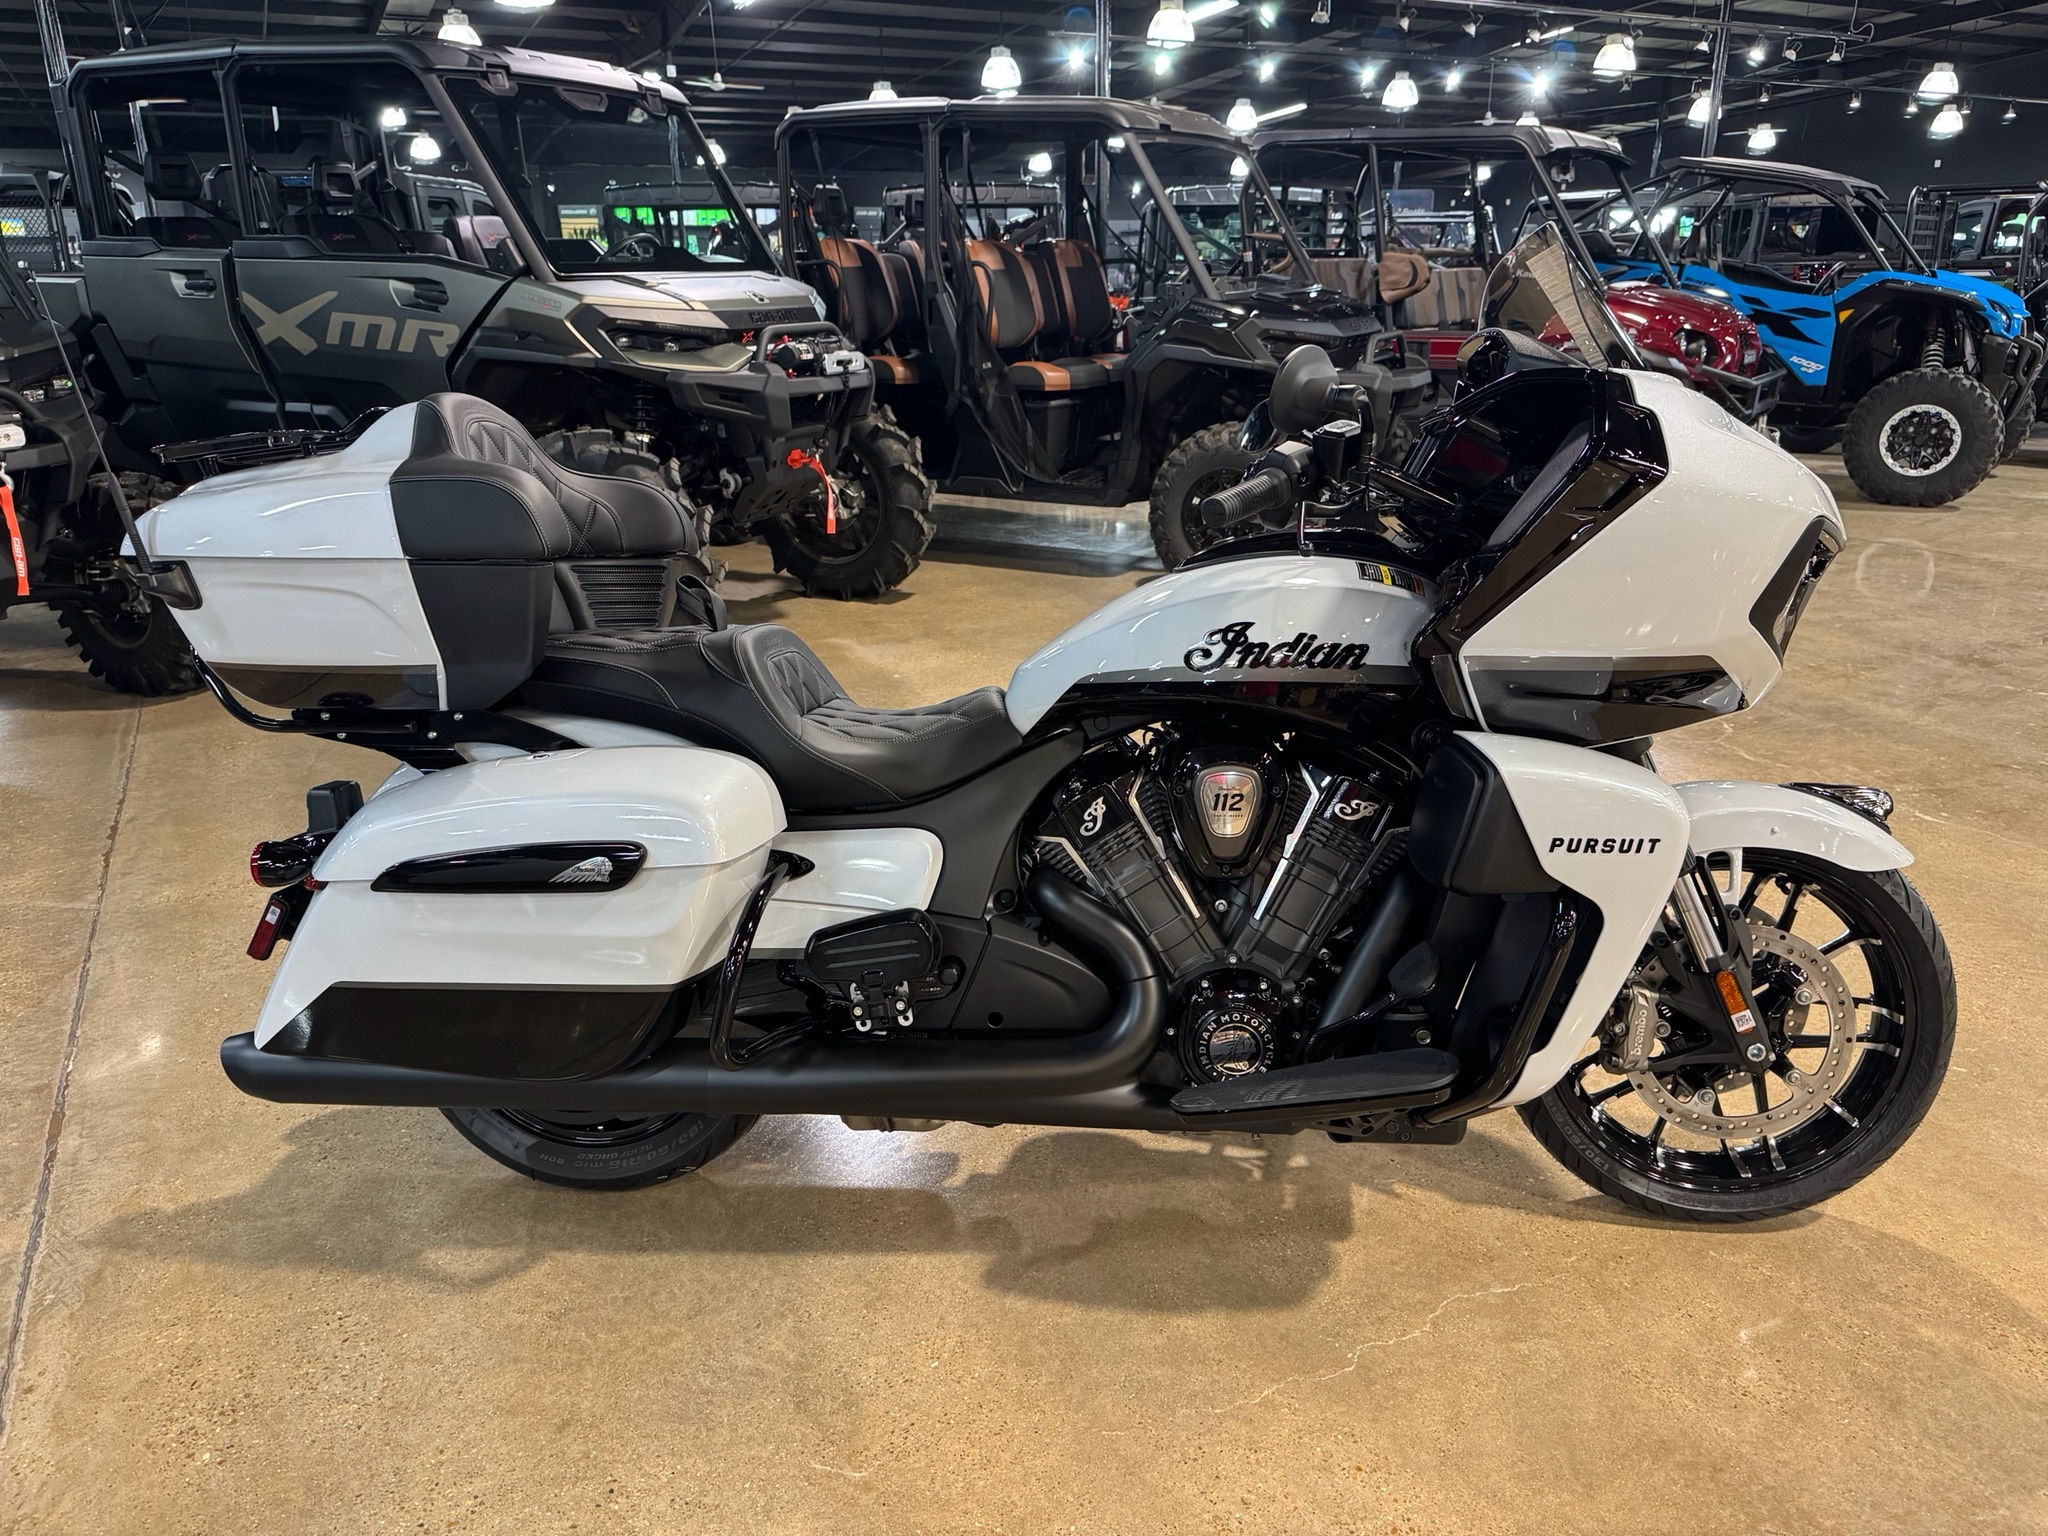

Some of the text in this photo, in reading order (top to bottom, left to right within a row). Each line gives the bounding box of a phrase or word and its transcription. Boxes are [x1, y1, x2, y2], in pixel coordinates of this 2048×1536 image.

[1789, 355, 1826, 371] 1000
[1183, 621, 1370, 673] Indian
[1212, 793, 1245, 812] 112
[1548, 837, 1662, 854] PURSUIT
[1198, 1013, 1275, 1074] INDIAN MOTORCYCLE
[1630, 1009, 1648, 1056] brembo
[646, 1119, 705, 1161] 180/60
[1562, 1124, 1611, 1172] 130/60
